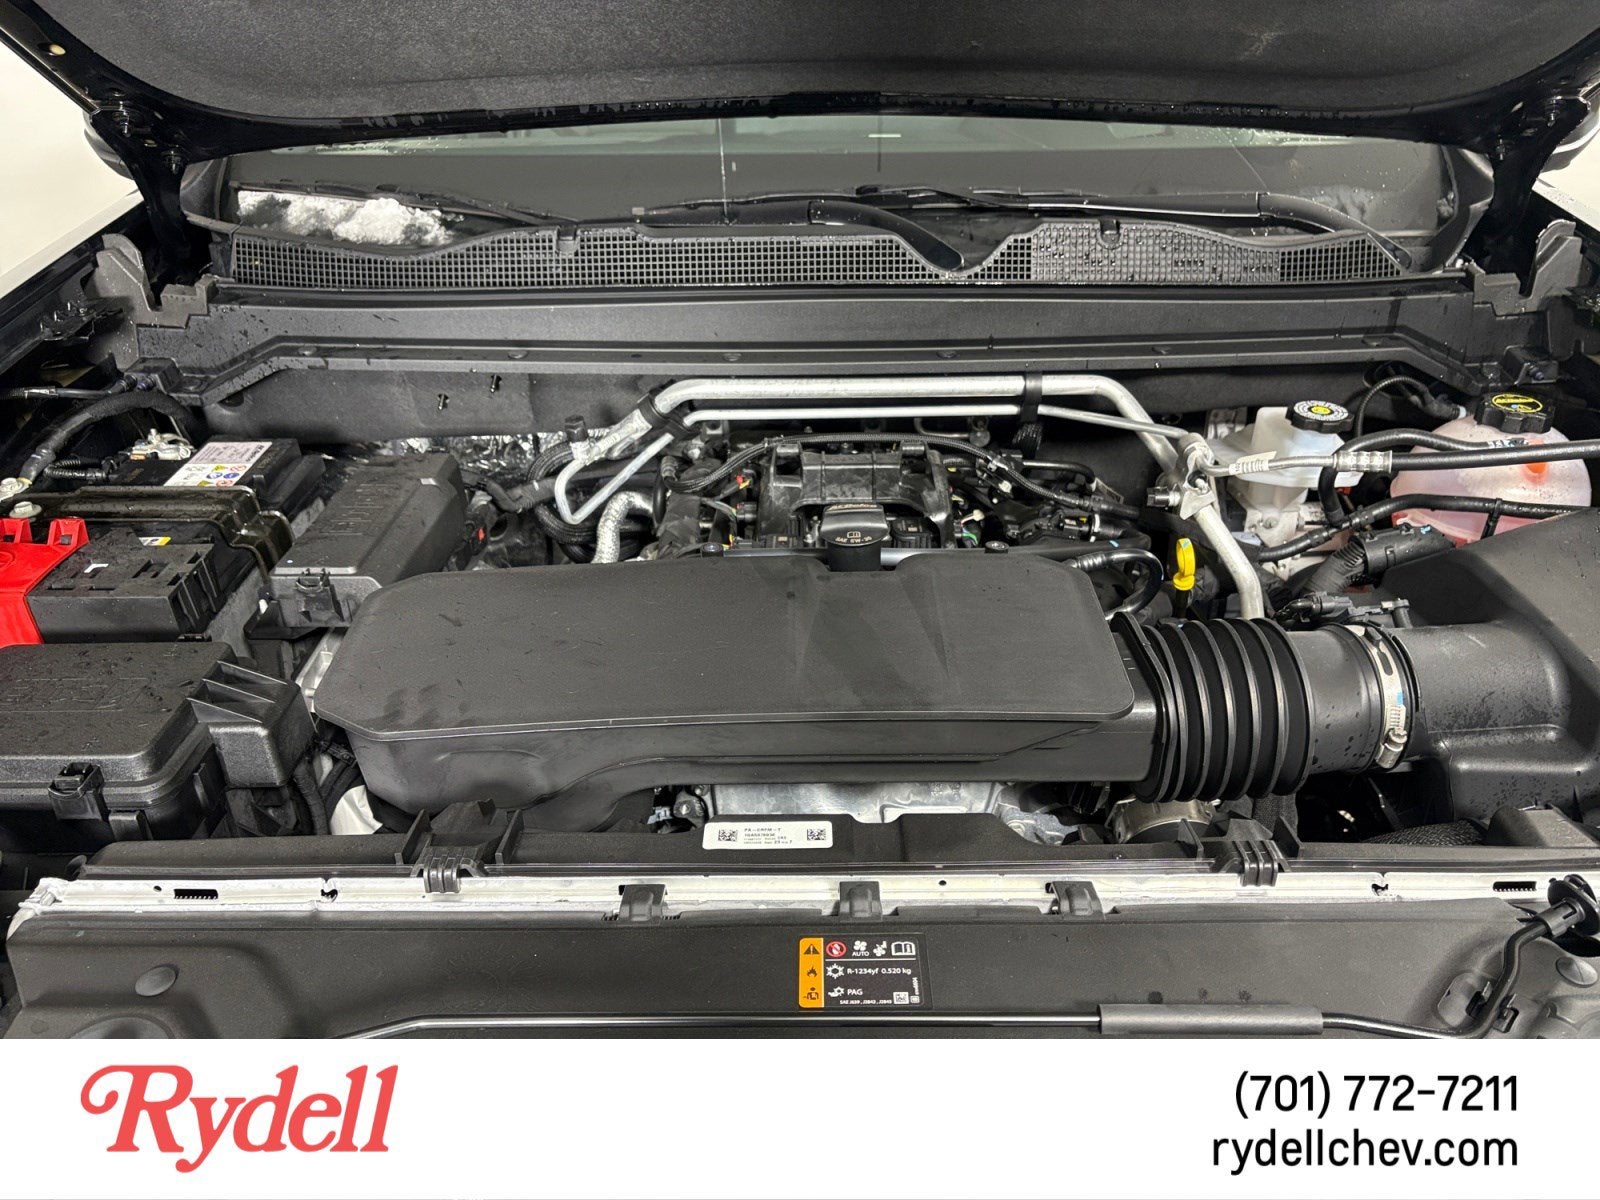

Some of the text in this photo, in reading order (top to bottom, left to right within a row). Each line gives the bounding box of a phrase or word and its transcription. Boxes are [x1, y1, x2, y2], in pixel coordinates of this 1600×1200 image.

[847, 968, 879, 976] R-1234yf
[902, 967, 912, 975] kg
[847, 988, 863, 996] PAG
